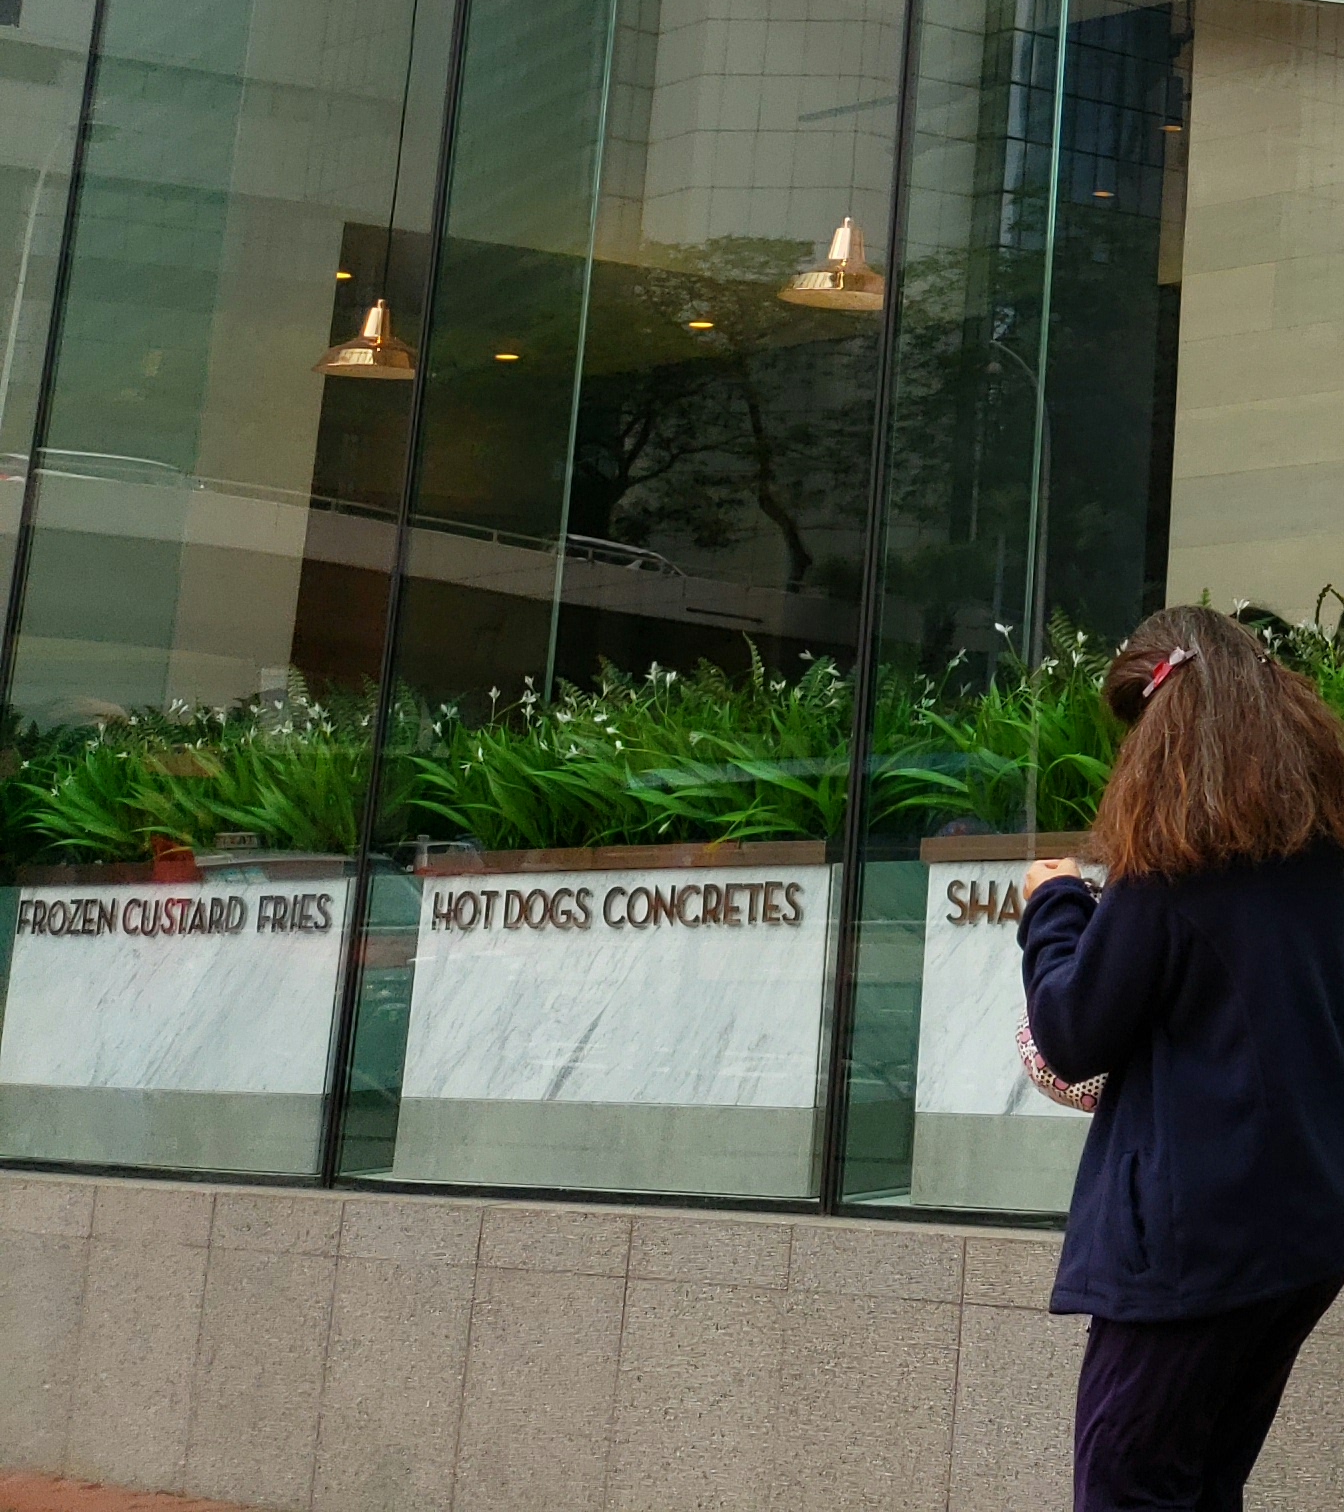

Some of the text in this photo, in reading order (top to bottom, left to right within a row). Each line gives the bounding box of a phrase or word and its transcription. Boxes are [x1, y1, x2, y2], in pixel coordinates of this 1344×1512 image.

[16, 893, 332, 936] FROZEN CUSTARD FRIES
[431, 881, 804, 930] HOT DOGS CONCRETES
